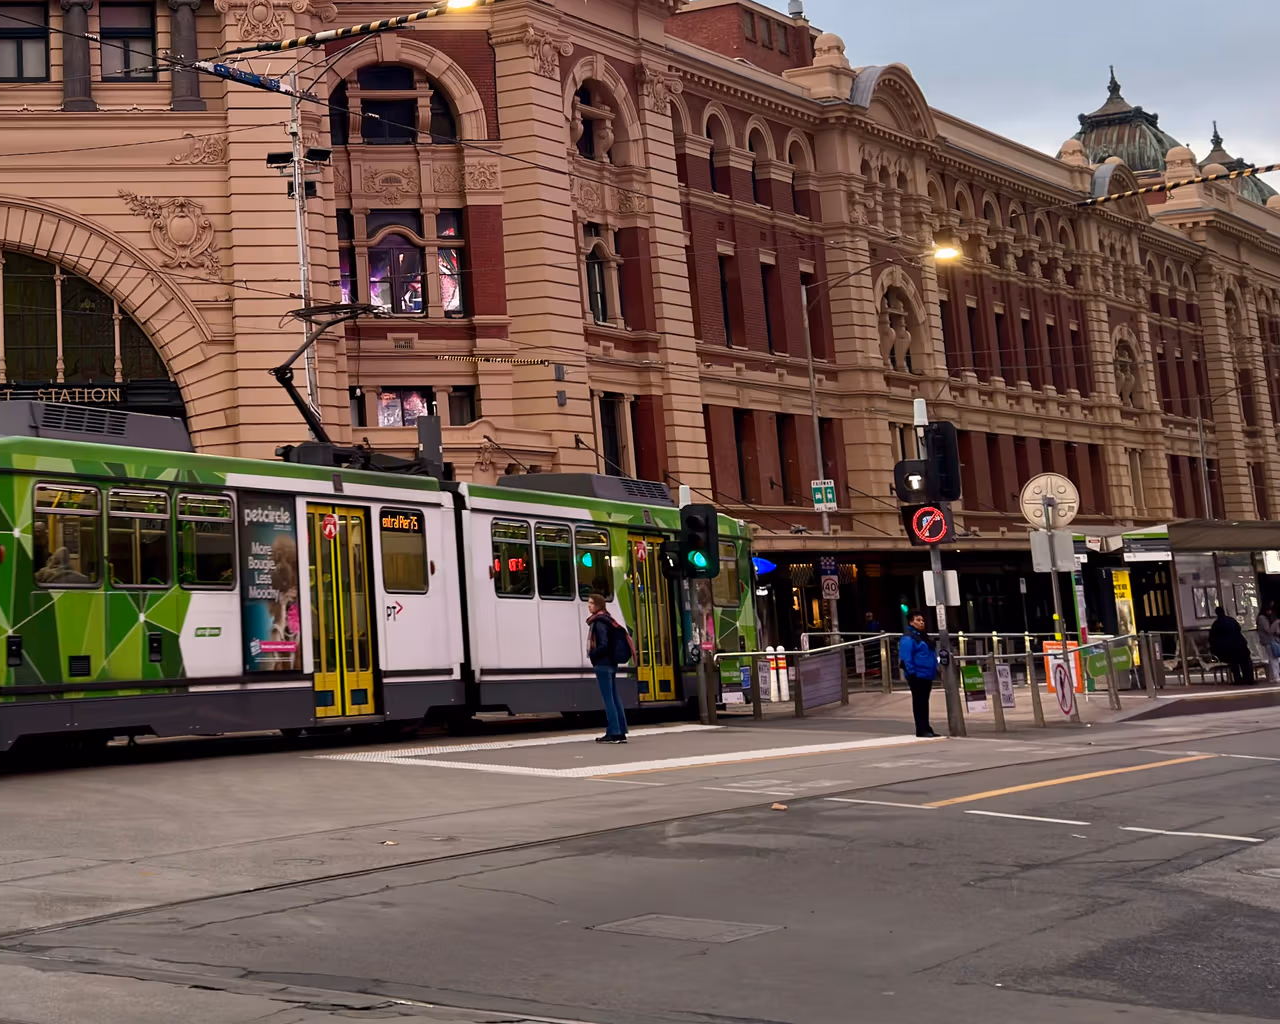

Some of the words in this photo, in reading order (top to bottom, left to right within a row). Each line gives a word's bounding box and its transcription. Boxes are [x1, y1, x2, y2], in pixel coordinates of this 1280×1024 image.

[36, 387, 121, 403] STATION
[251, 542, 272, 555] More
[255, 572, 272, 584] Less
[825, 583, 837, 592] 40
